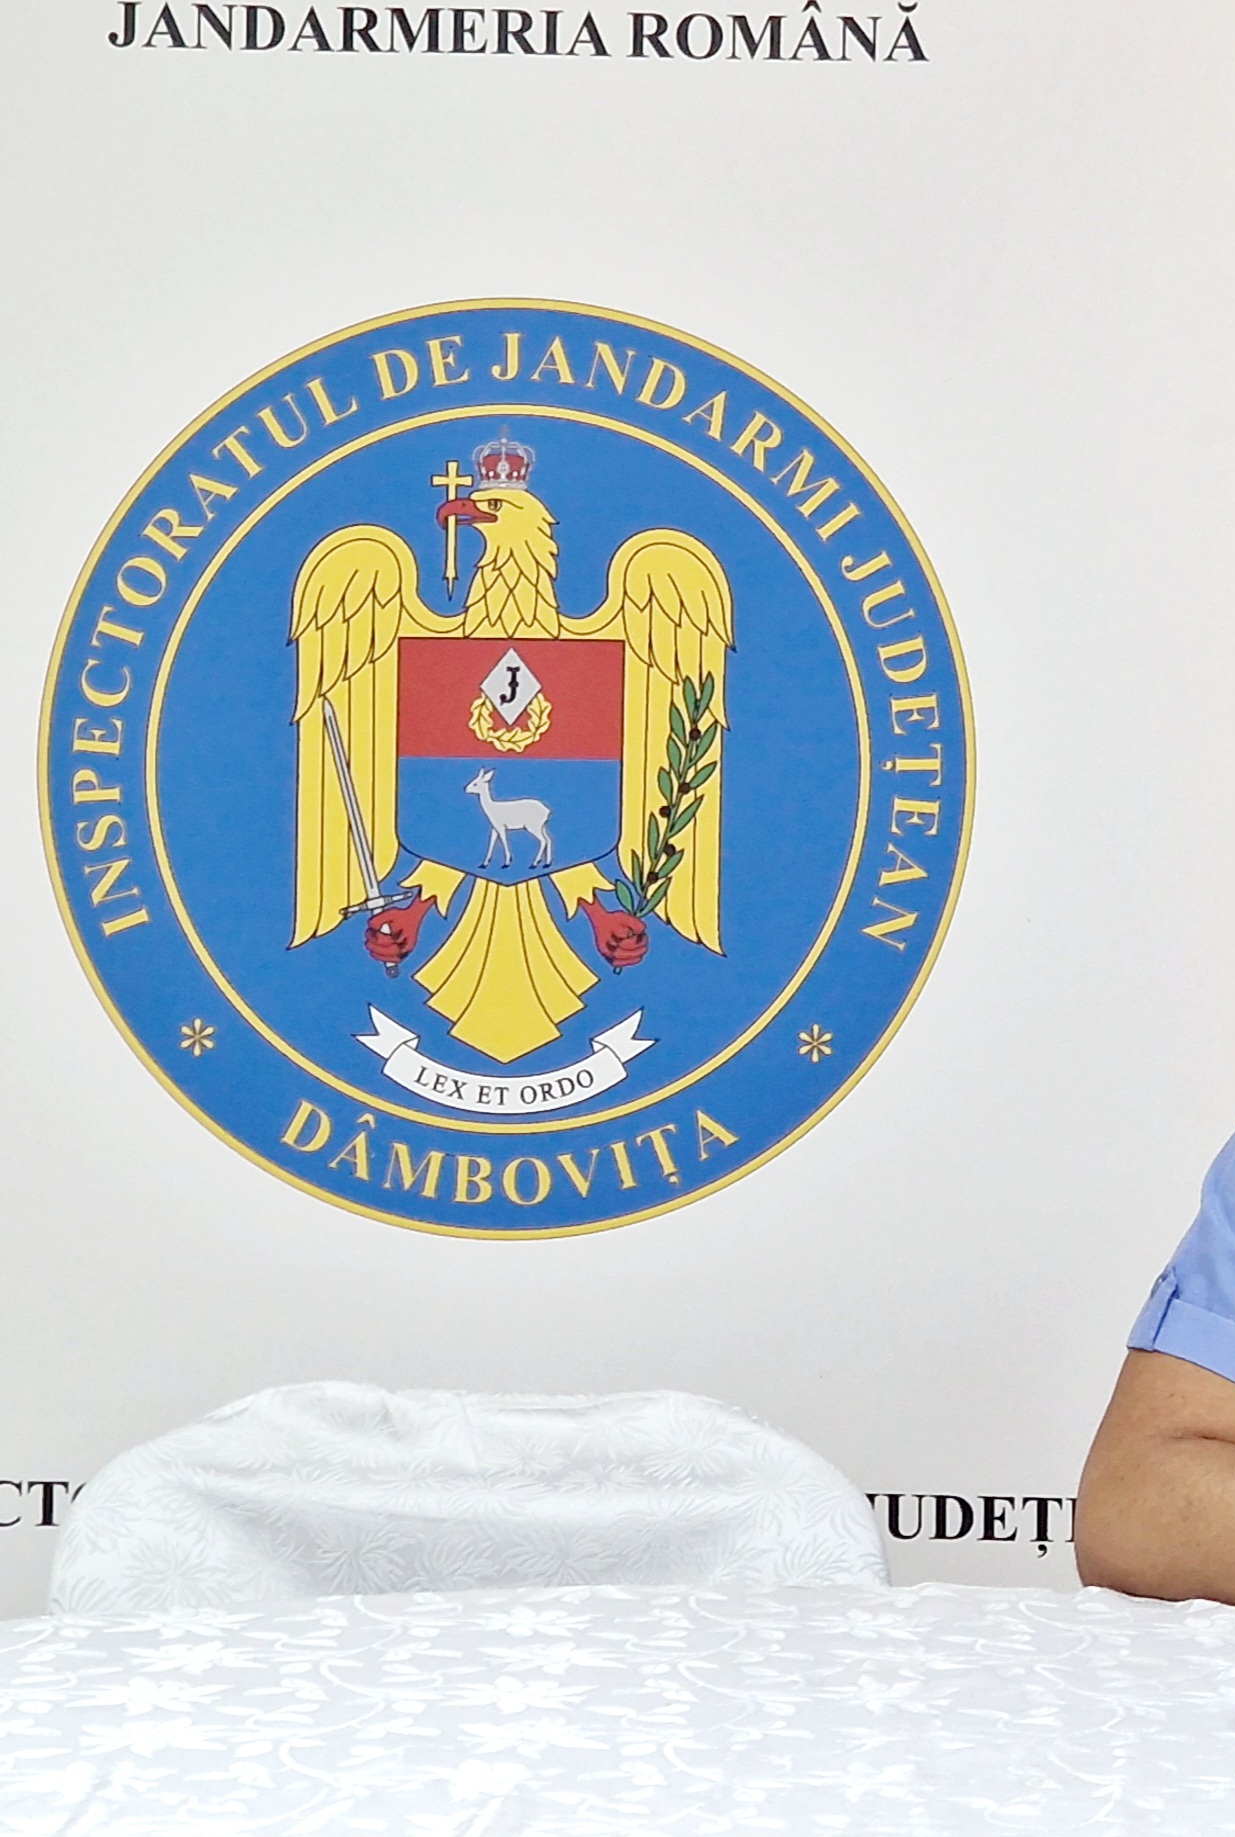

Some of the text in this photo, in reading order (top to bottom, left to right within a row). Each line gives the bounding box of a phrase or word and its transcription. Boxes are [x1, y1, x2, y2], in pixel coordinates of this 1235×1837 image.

[107, 0, 931, 62] JANDARMERIA ROMÂNĂ
[72, 332, 944, 952] INSPECTORATUL DE JANDARMI JUDEȚEAN
[499, 666, 521, 706] J
[414, 1066, 594, 1106] LEX ET ORDO
[281, 1098, 739, 1207] DÂMBOVIȚA
[0, 1479, 1077, 1559] CT UDEȚ
